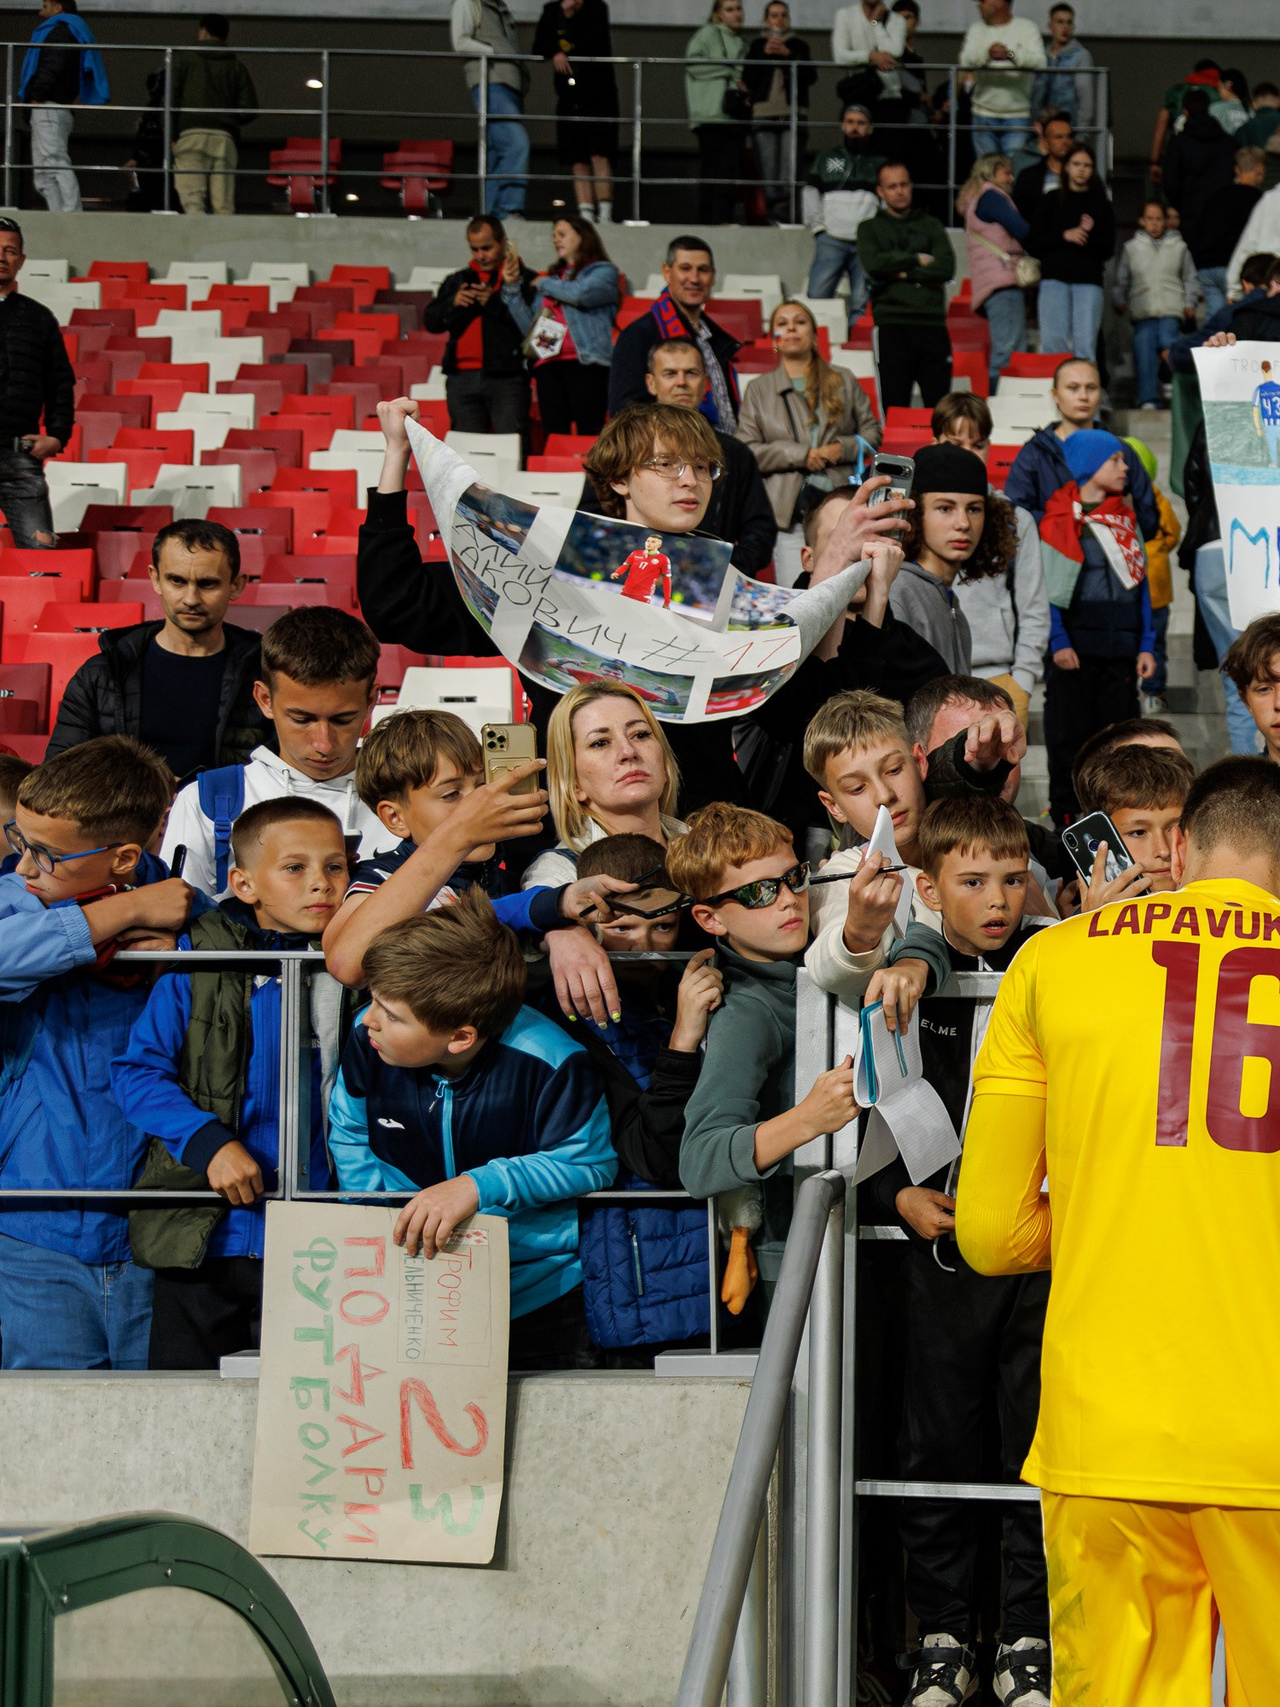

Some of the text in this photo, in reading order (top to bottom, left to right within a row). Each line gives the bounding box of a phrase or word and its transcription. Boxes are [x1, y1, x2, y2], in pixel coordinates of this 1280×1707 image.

[452, 524, 552, 594] АЛИЙ
[453, 543, 627, 654] АКОВИЧ
[920, 1018, 957, 1036] ELME
[403, 1252, 425, 1360] ЕЛЬНИЧЕНКО
[437, 1246, 472, 1347] ТРОФИМ
[289, 1236, 338, 1551] ФУТБОЛКУ
[332, 1236, 390, 1545] ПОДАРИ
[400, 1377, 489, 1537] 23
